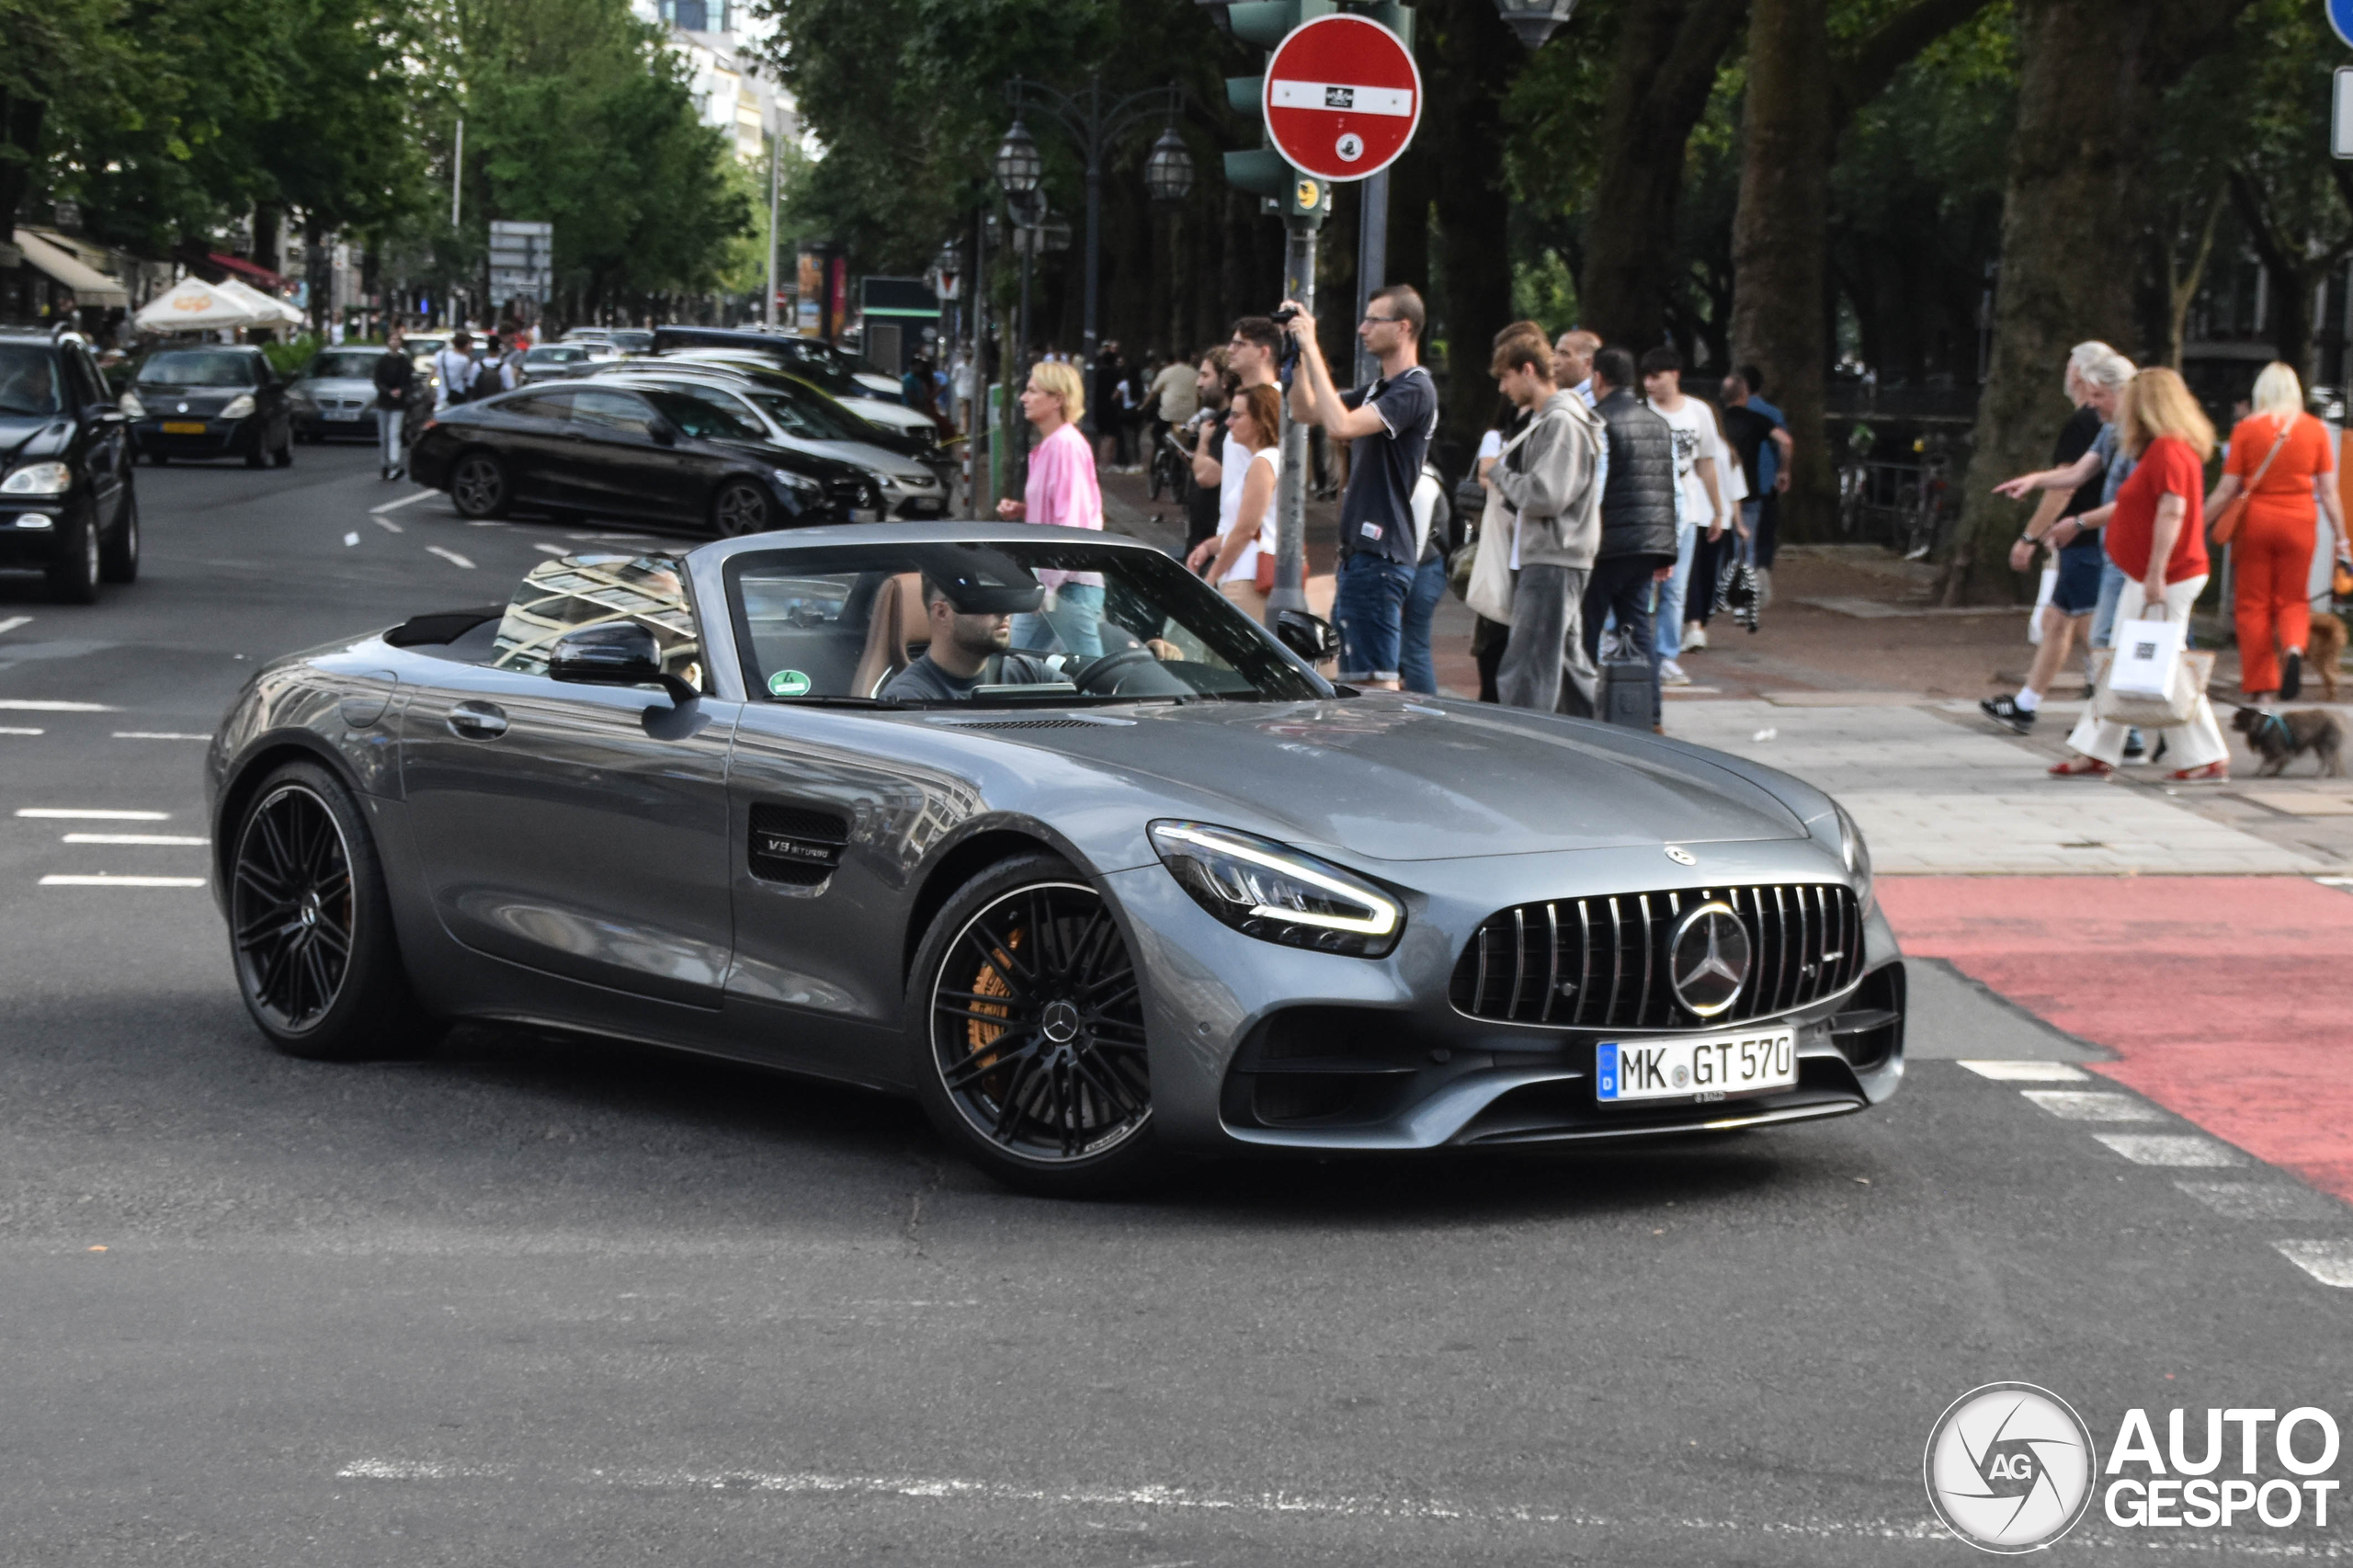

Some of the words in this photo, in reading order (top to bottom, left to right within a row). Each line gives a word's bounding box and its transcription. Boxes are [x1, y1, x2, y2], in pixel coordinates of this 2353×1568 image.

[783, 672, 793, 683] 4
[768, 839, 790, 852] V8
[1621, 1047, 1667, 1091] MK
[1693, 1042, 1733, 1085] GT
[1741, 1036, 1790, 1080] 570
[1603, 1078, 1613, 1091] D
